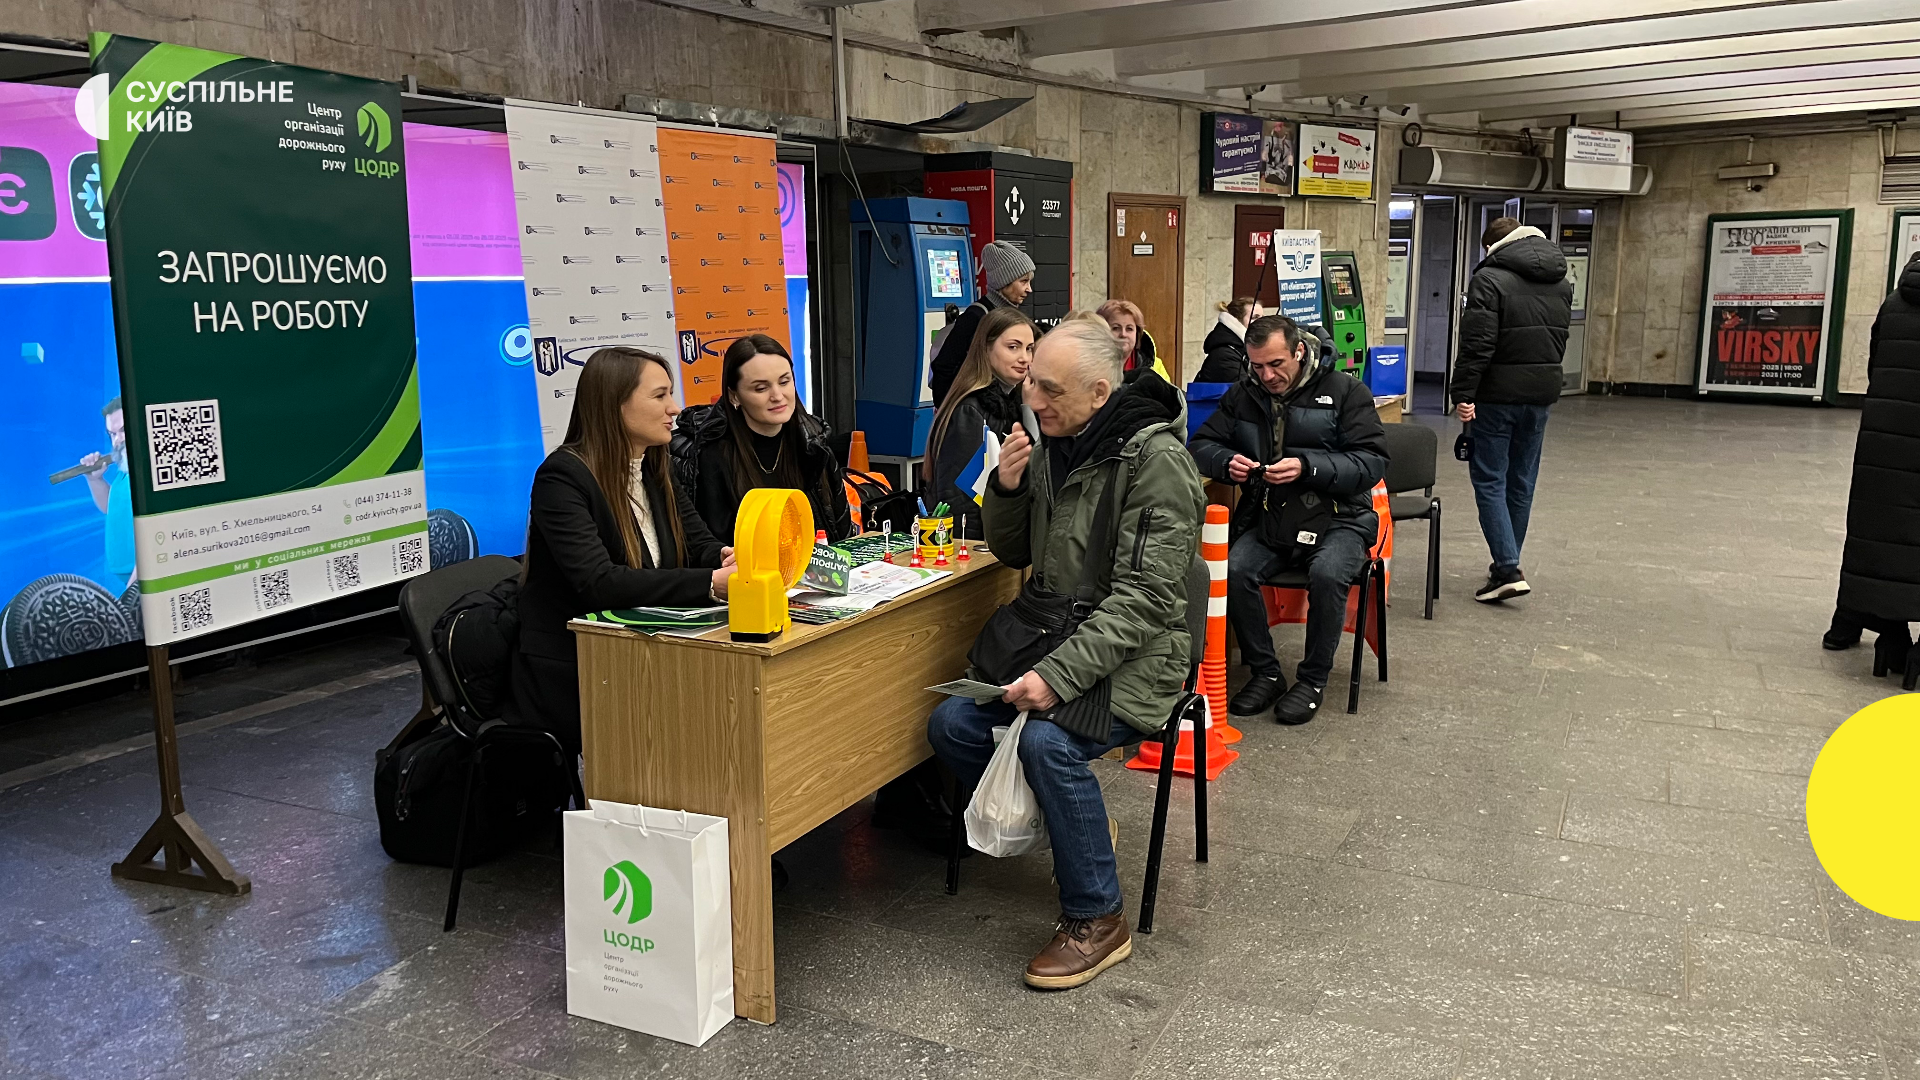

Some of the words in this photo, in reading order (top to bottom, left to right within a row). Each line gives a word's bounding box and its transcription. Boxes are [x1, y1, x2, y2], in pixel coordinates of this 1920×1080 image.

[307, 102, 342, 120] Центр
[284, 119, 344, 136] організації
[278, 137, 346, 154] дорожнього
[322, 159, 346, 172] руху
[354, 158, 400, 179] ЦОДР
[1042, 200, 1060, 210] 23377
[158, 250, 388, 284] ЗАПРОШУЄМО
[194, 301, 244, 333] НА
[252, 300, 369, 332] РОБОТУ
[1718, 330, 1820, 364] VIRSKY
[355, 495, 374, 508] (044)
[375, 488, 412, 503] 374-11-38
[355, 502, 422, 522] codr.kyivcity.gov.ua
[171, 528, 198, 542] Київ,
[200, 523, 220, 538] вул.
[221, 520, 232, 532] Б.
[233, 510, 310, 530] Хмельницького,
[312, 504, 322, 514] 54
[173, 524, 310, 560] alena.surikova2016@gmail.com
[233, 560, 250, 572] ми
[254, 558, 261, 569] у
[267, 544, 325, 564] соціальних
[330, 534, 372, 549] мережах
[812, 546, 835, 560] РОБО
[810, 556, 848, 573] ЗАПРОШ
[64, 624, 103, 650] OREO
[604, 928, 655, 954] ЦОДР
[604, 952, 625, 964] Центр
[604, 964, 639, 978] організації
[603, 974, 644, 989] дорожнього
[603, 984, 619, 994] руху
